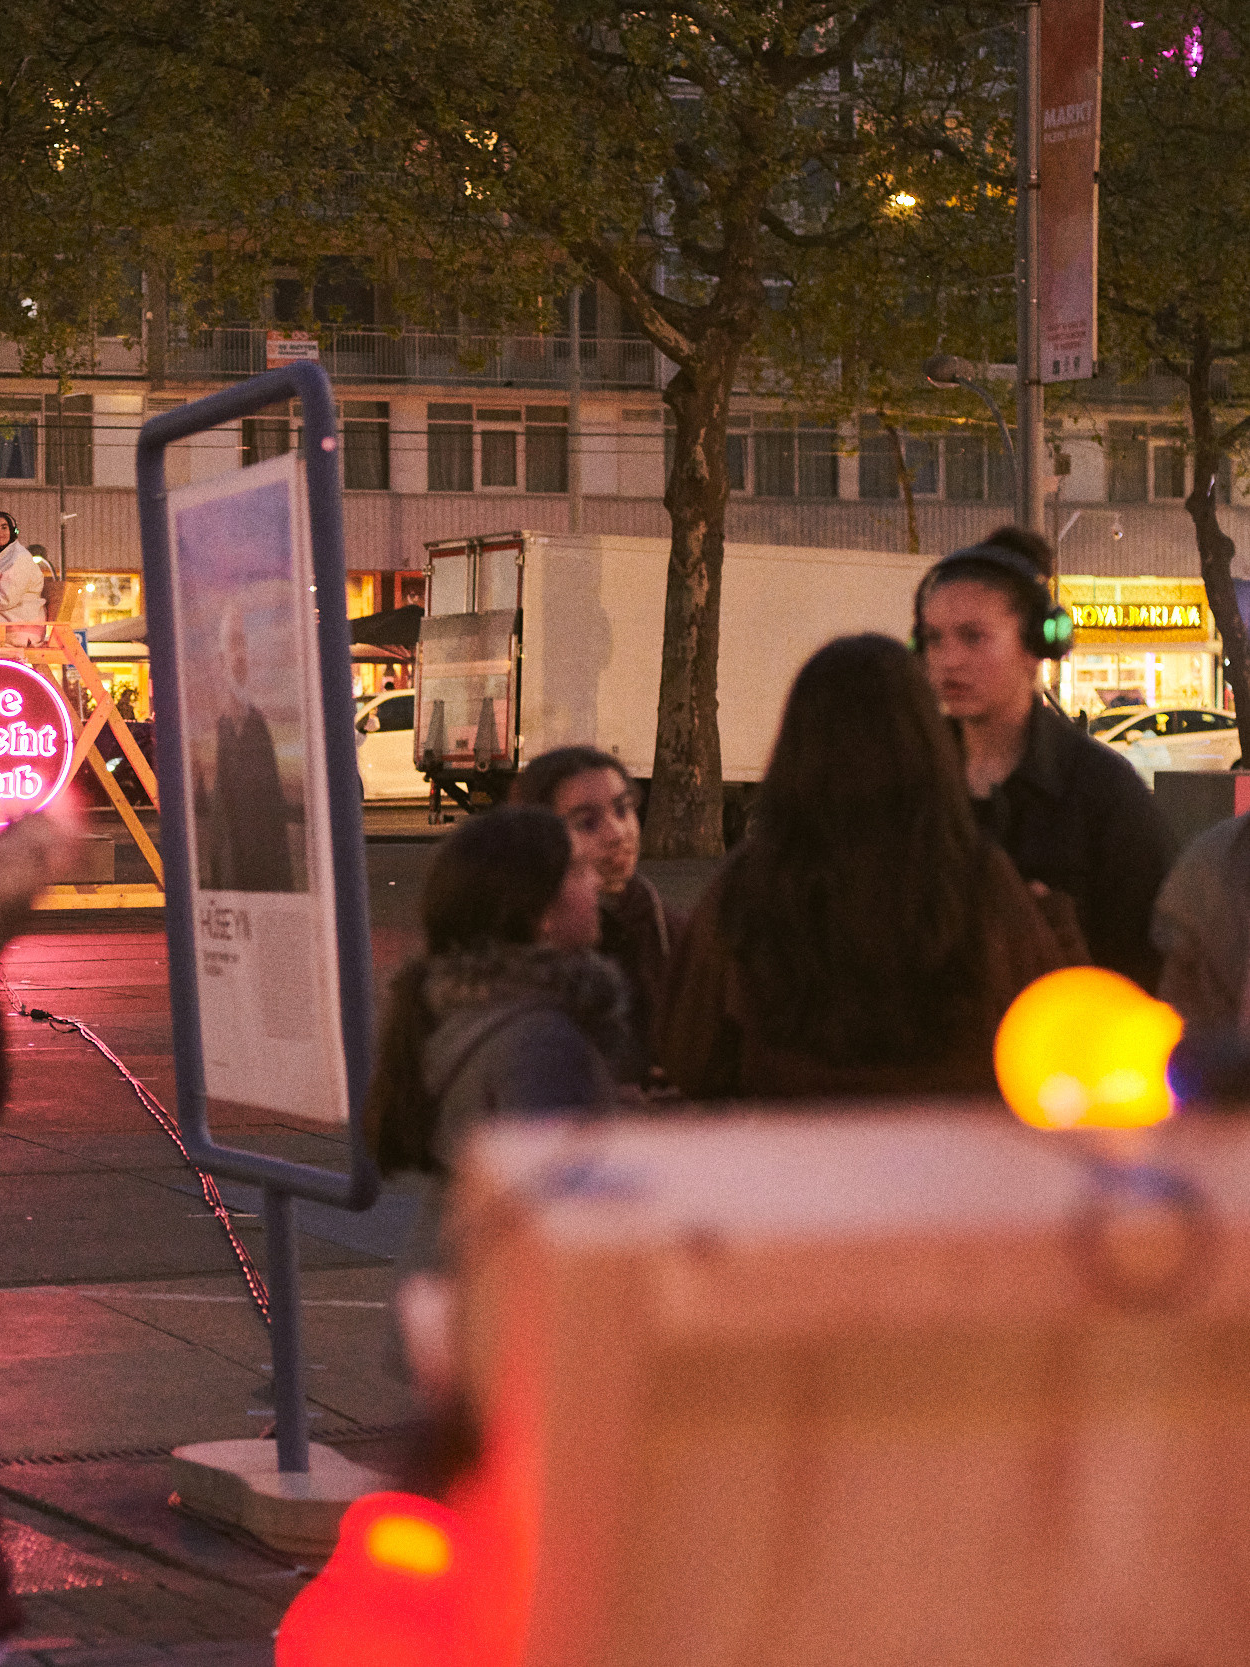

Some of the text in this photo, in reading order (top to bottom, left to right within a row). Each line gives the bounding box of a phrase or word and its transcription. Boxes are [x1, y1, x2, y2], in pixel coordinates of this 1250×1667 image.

[1043, 100, 1093, 128] MARKT
[1072, 605, 1201, 626] ROYAL BAKLAVA
